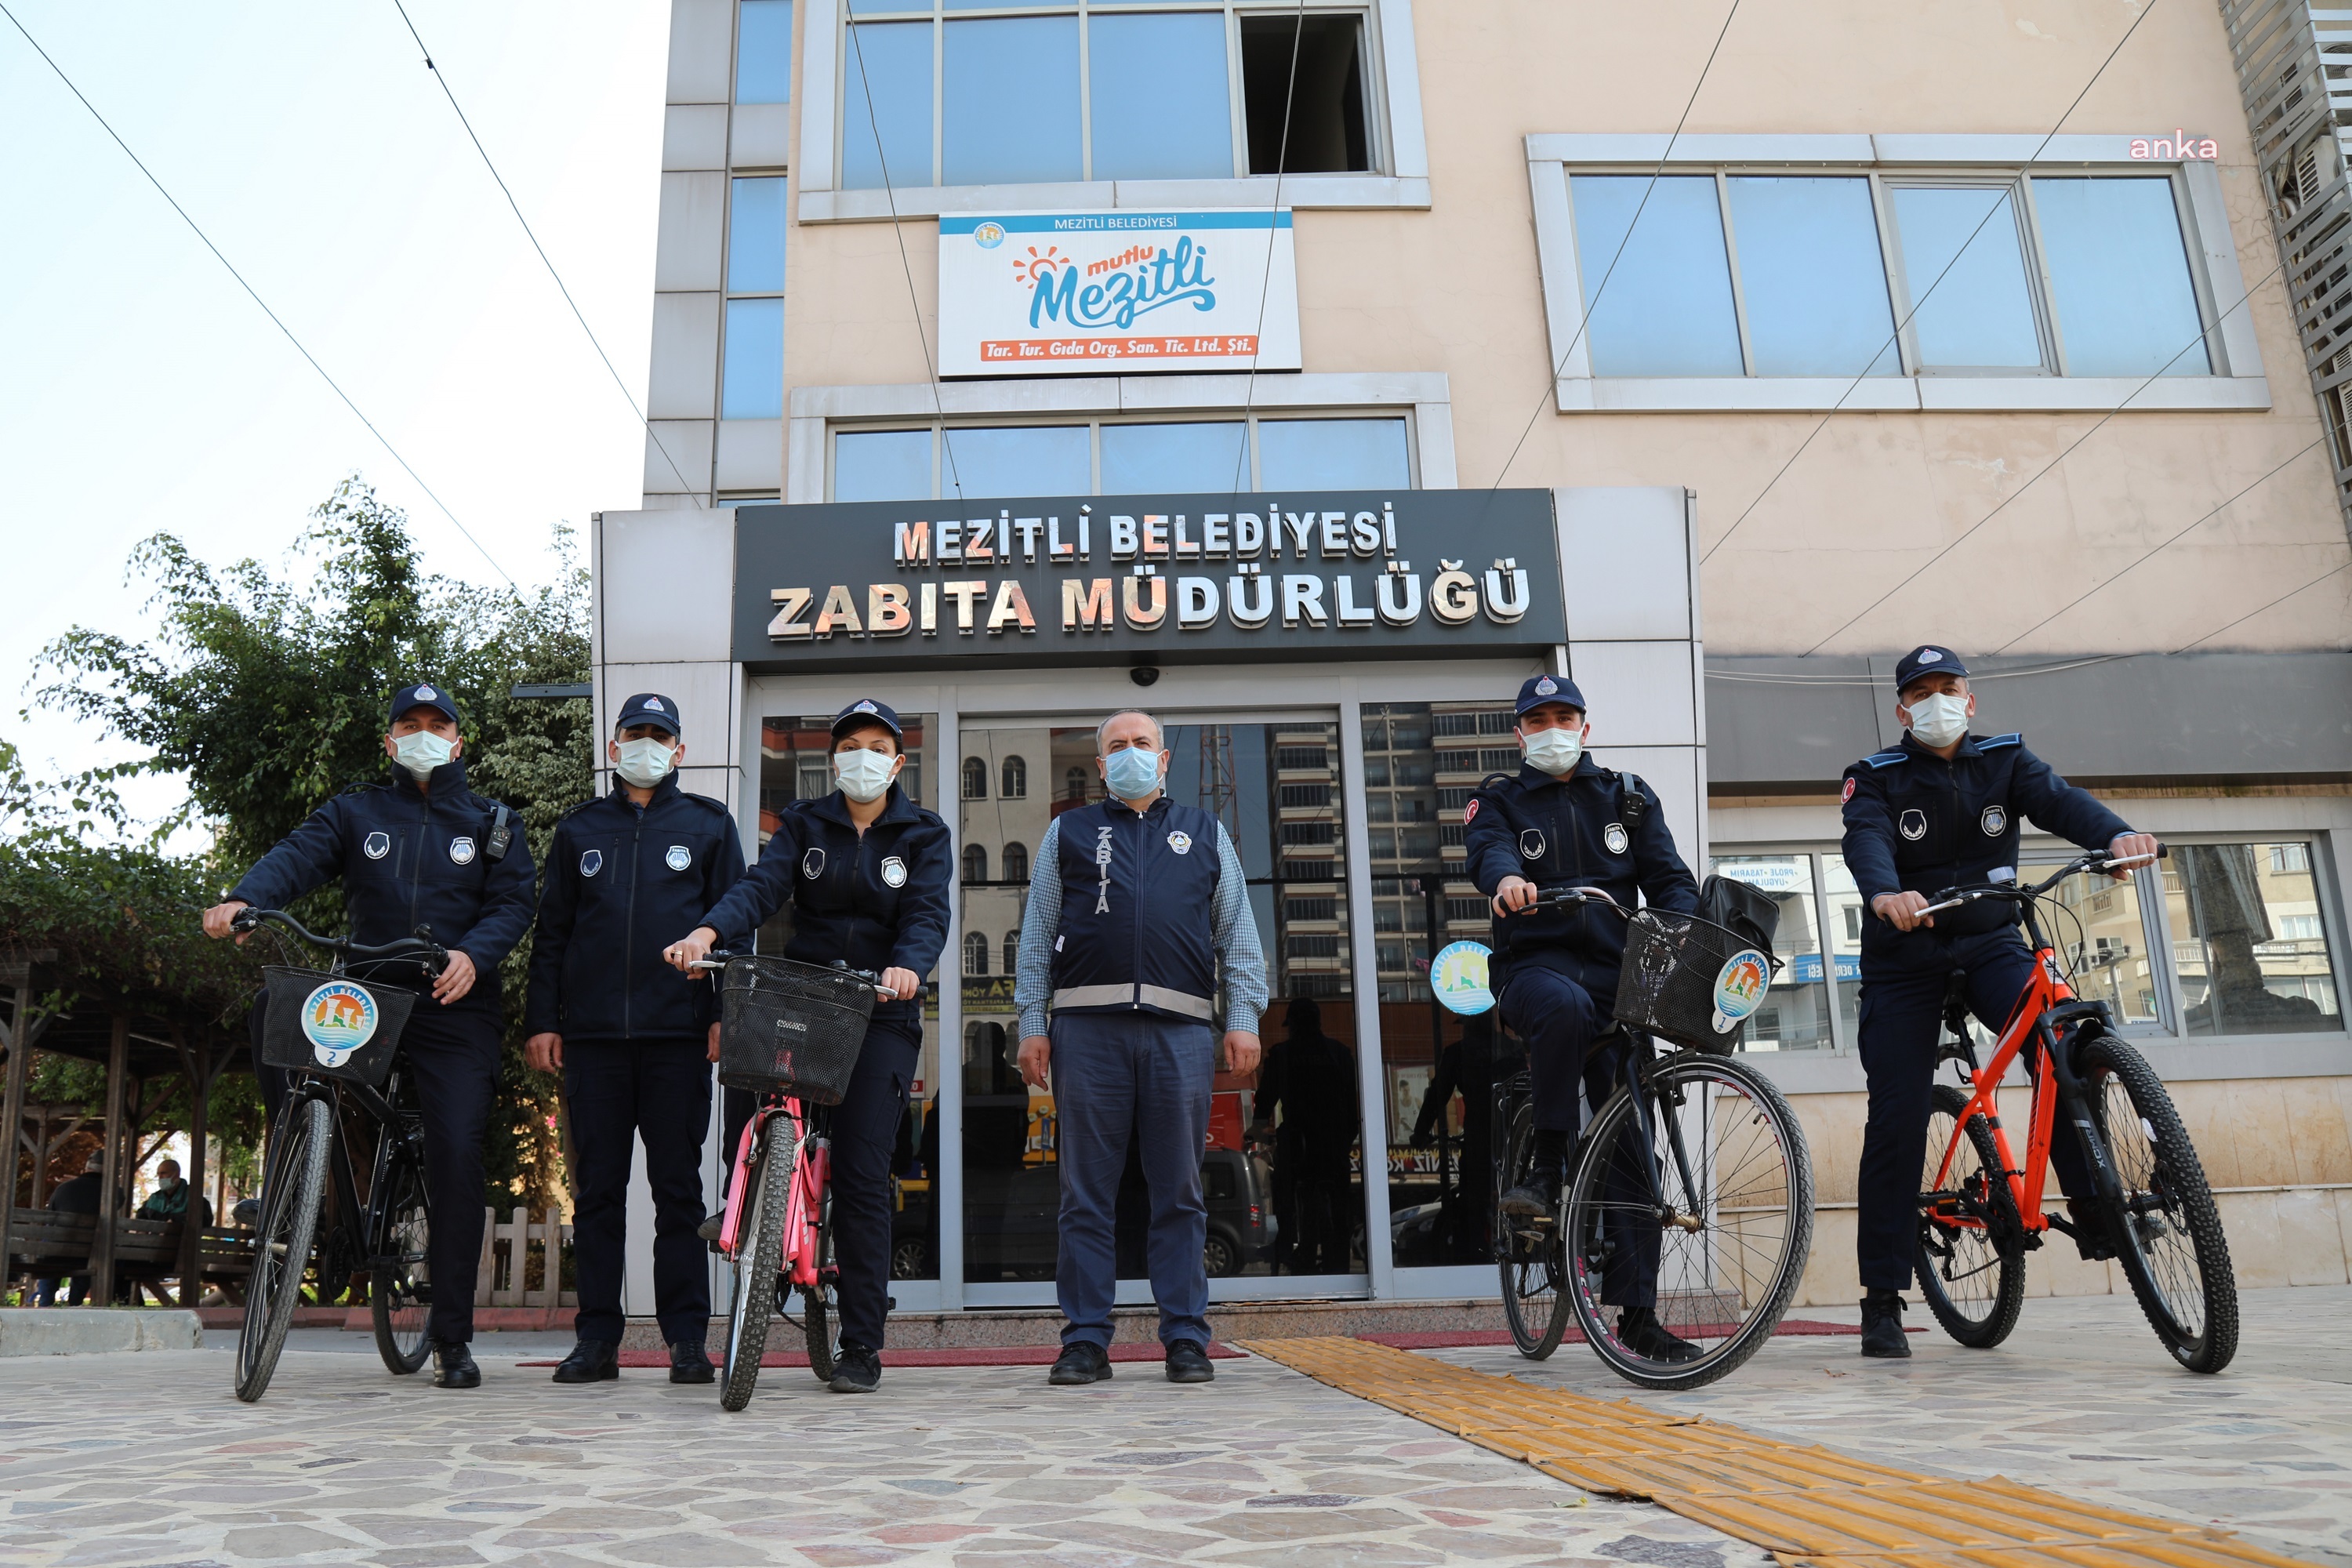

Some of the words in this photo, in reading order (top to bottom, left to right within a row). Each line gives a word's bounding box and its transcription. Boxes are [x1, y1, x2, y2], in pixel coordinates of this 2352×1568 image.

[1054, 216, 1105, 229] MEZİTLİ
[1108, 215, 1178, 228] BELEDİYESİ
[1087, 245, 1153, 277] mutlu
[1029, 235, 1216, 329] Mezitli
[987, 343, 1013, 358] Tar.
[1018, 342, 1044, 357] Tur.
[1049, 340, 1084, 355] Gıda
[1089, 340, 1122, 358] Org.
[1127, 339, 1159, 354] San.
[1165, 339, 1189, 353] Tic.
[1193, 337, 1221, 352] Ltd.
[1227, 337, 1252, 355] Şti.
[894, 504, 1093, 566] MEZİTLİ
[1109, 501, 1398, 561] BELEDİYESİ
[768, 579, 1036, 641] ZABITA
[1061, 557, 1531, 631] MÜDÜRLÜĞÜ
[1095, 826, 1112, 914] ZABITA
[1460, 945, 1489, 957] BELE
[309, 987, 335, 1022] MEZİTLİ
[1719, 1017, 1726, 1029] 1
[327, 1051, 336, 1062] 2
